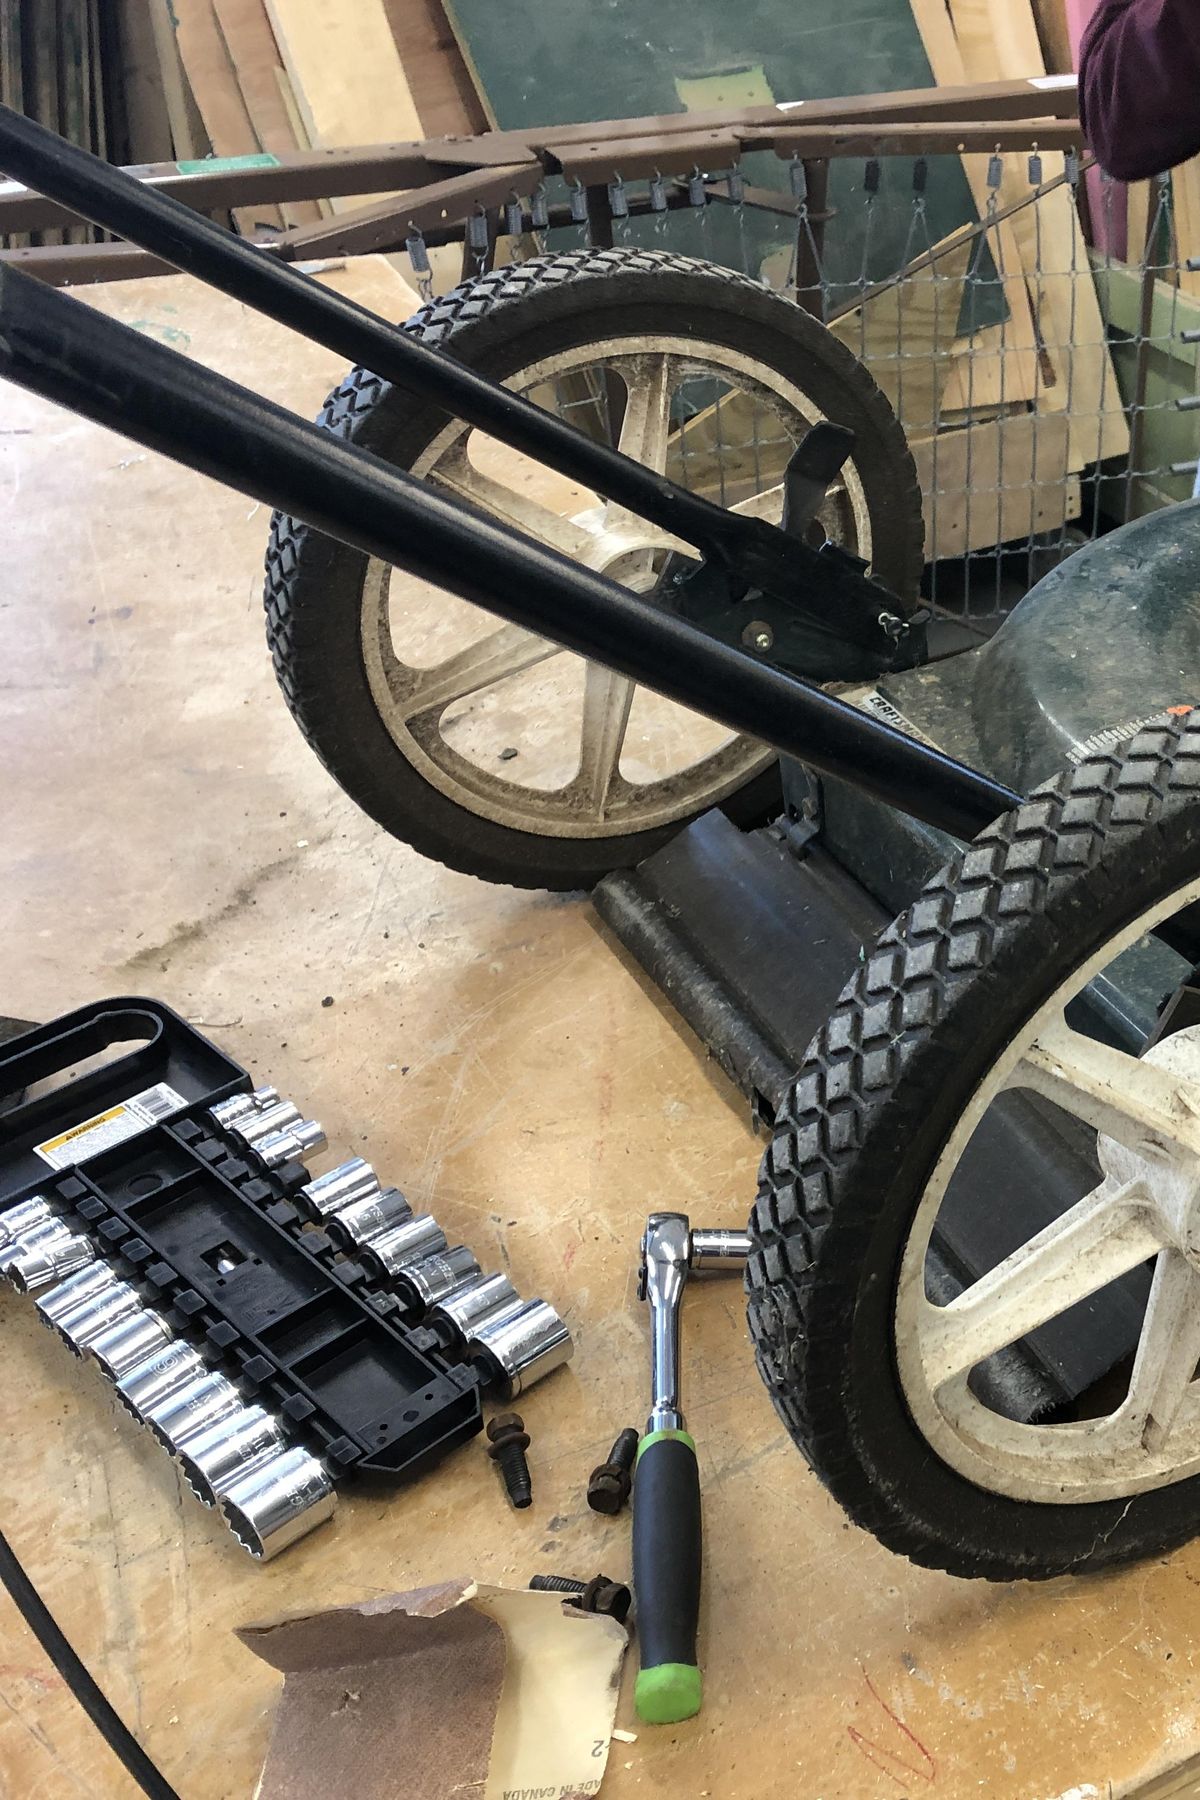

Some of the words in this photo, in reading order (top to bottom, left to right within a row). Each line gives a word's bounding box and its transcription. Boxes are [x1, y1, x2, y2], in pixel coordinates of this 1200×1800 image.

[70, 1116, 107, 1139] WARNING
[502, 1785, 556, 1800] CANADA
[559, 1783, 574, 1796] IN
[577, 1779, 601, 1793] ADE
